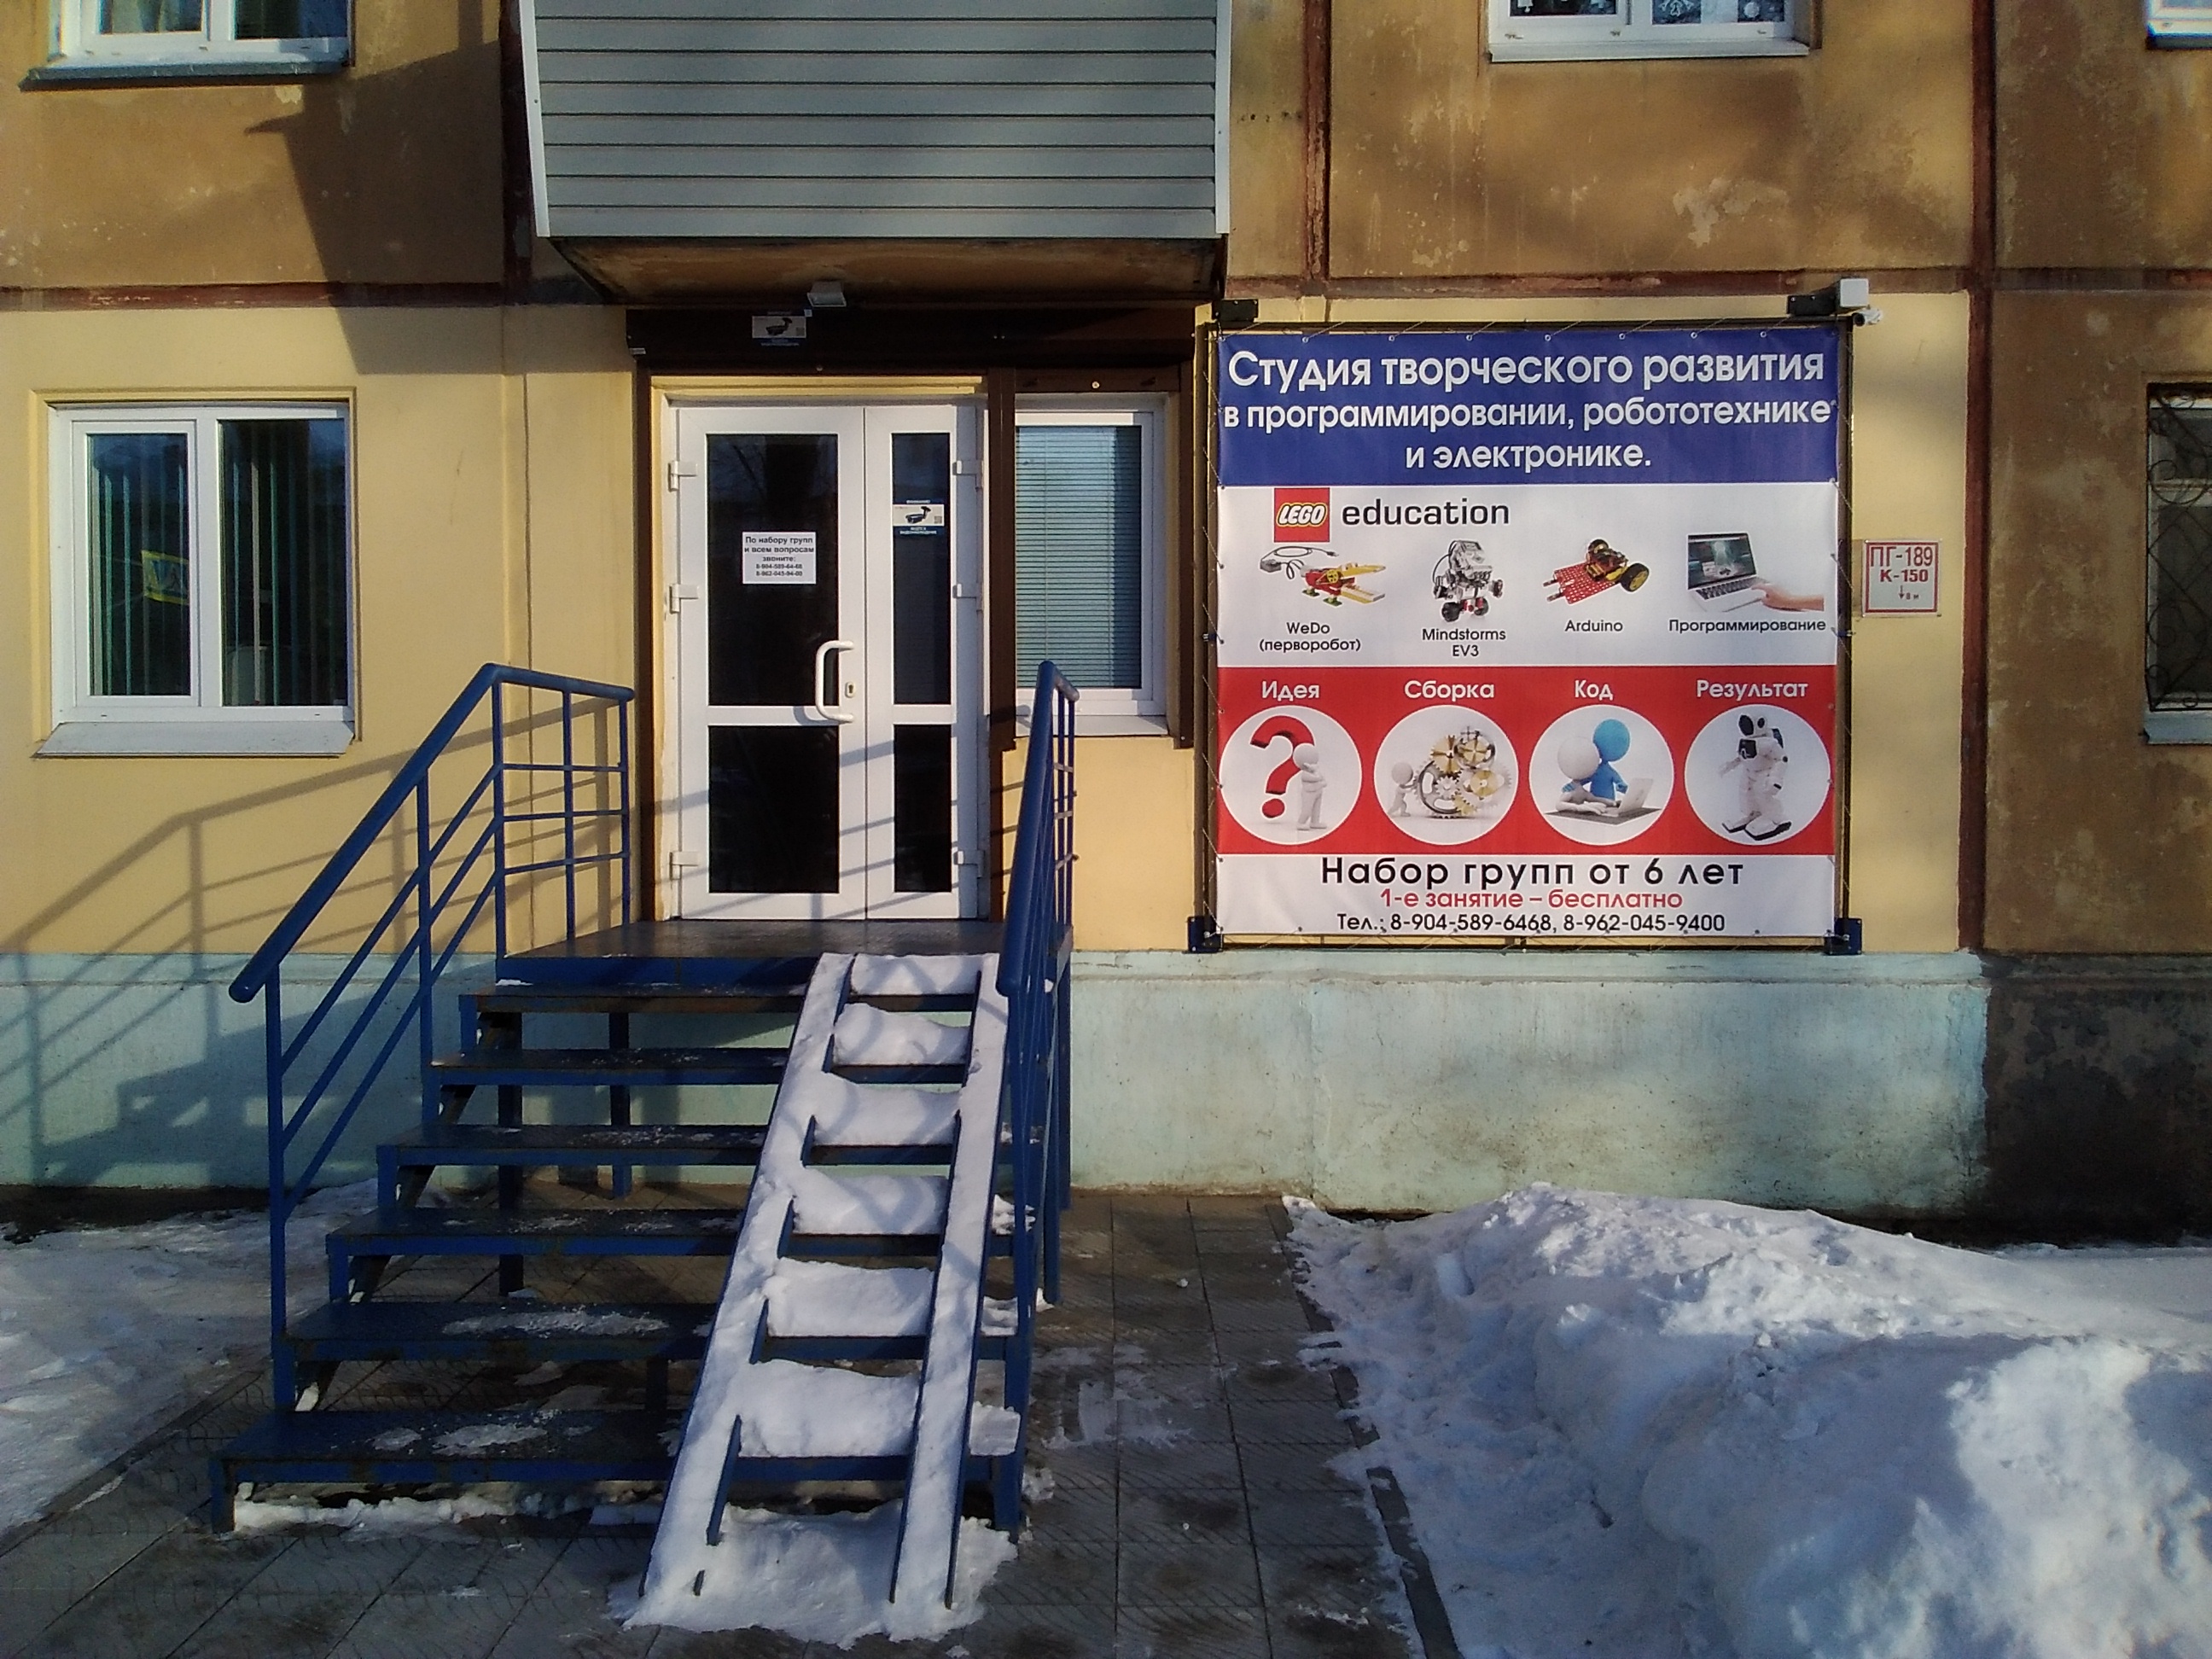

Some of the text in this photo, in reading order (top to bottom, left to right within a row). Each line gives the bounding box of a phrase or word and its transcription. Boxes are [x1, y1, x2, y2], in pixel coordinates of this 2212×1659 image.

[1229, 350, 1824, 394] Студия творческого развития
[1225, 396, 1831, 434] в программировании, робототехнике
[1406, 444, 1651, 474] и электронике.
[1278, 498, 1509, 526] LEGO education
[759, 536, 788, 544] набору
[1871, 546, 1933, 567] ПГ-189
[1880, 569, 1929, 582] К-150
[1287, 622, 1330, 635] WeDo
[1423, 628, 1506, 641] Mindstorms
[1565, 620, 1623, 632] Arduino
[1669, 620, 1826, 634] Программирование
[1260, 637, 1361, 653] (перворобот)
[1452, 645, 1479, 657] EV3
[1262, 680, 1319, 701] Идея
[1404, 680, 1494, 701] Сборка
[1575, 679, 1614, 701] Код
[1697, 679, 1808, 702] Результат
[1322, 857, 1743, 890] Набор групп от 6 лет
[1380, 888, 1419, 908] 1-е
[1425, 892, 1523, 908] занятие
[1548, 888, 1683, 908] бесплатно
[1337, 913, 1725, 933] Тел.: 8-904-589-6468, 8-962-045-9400
